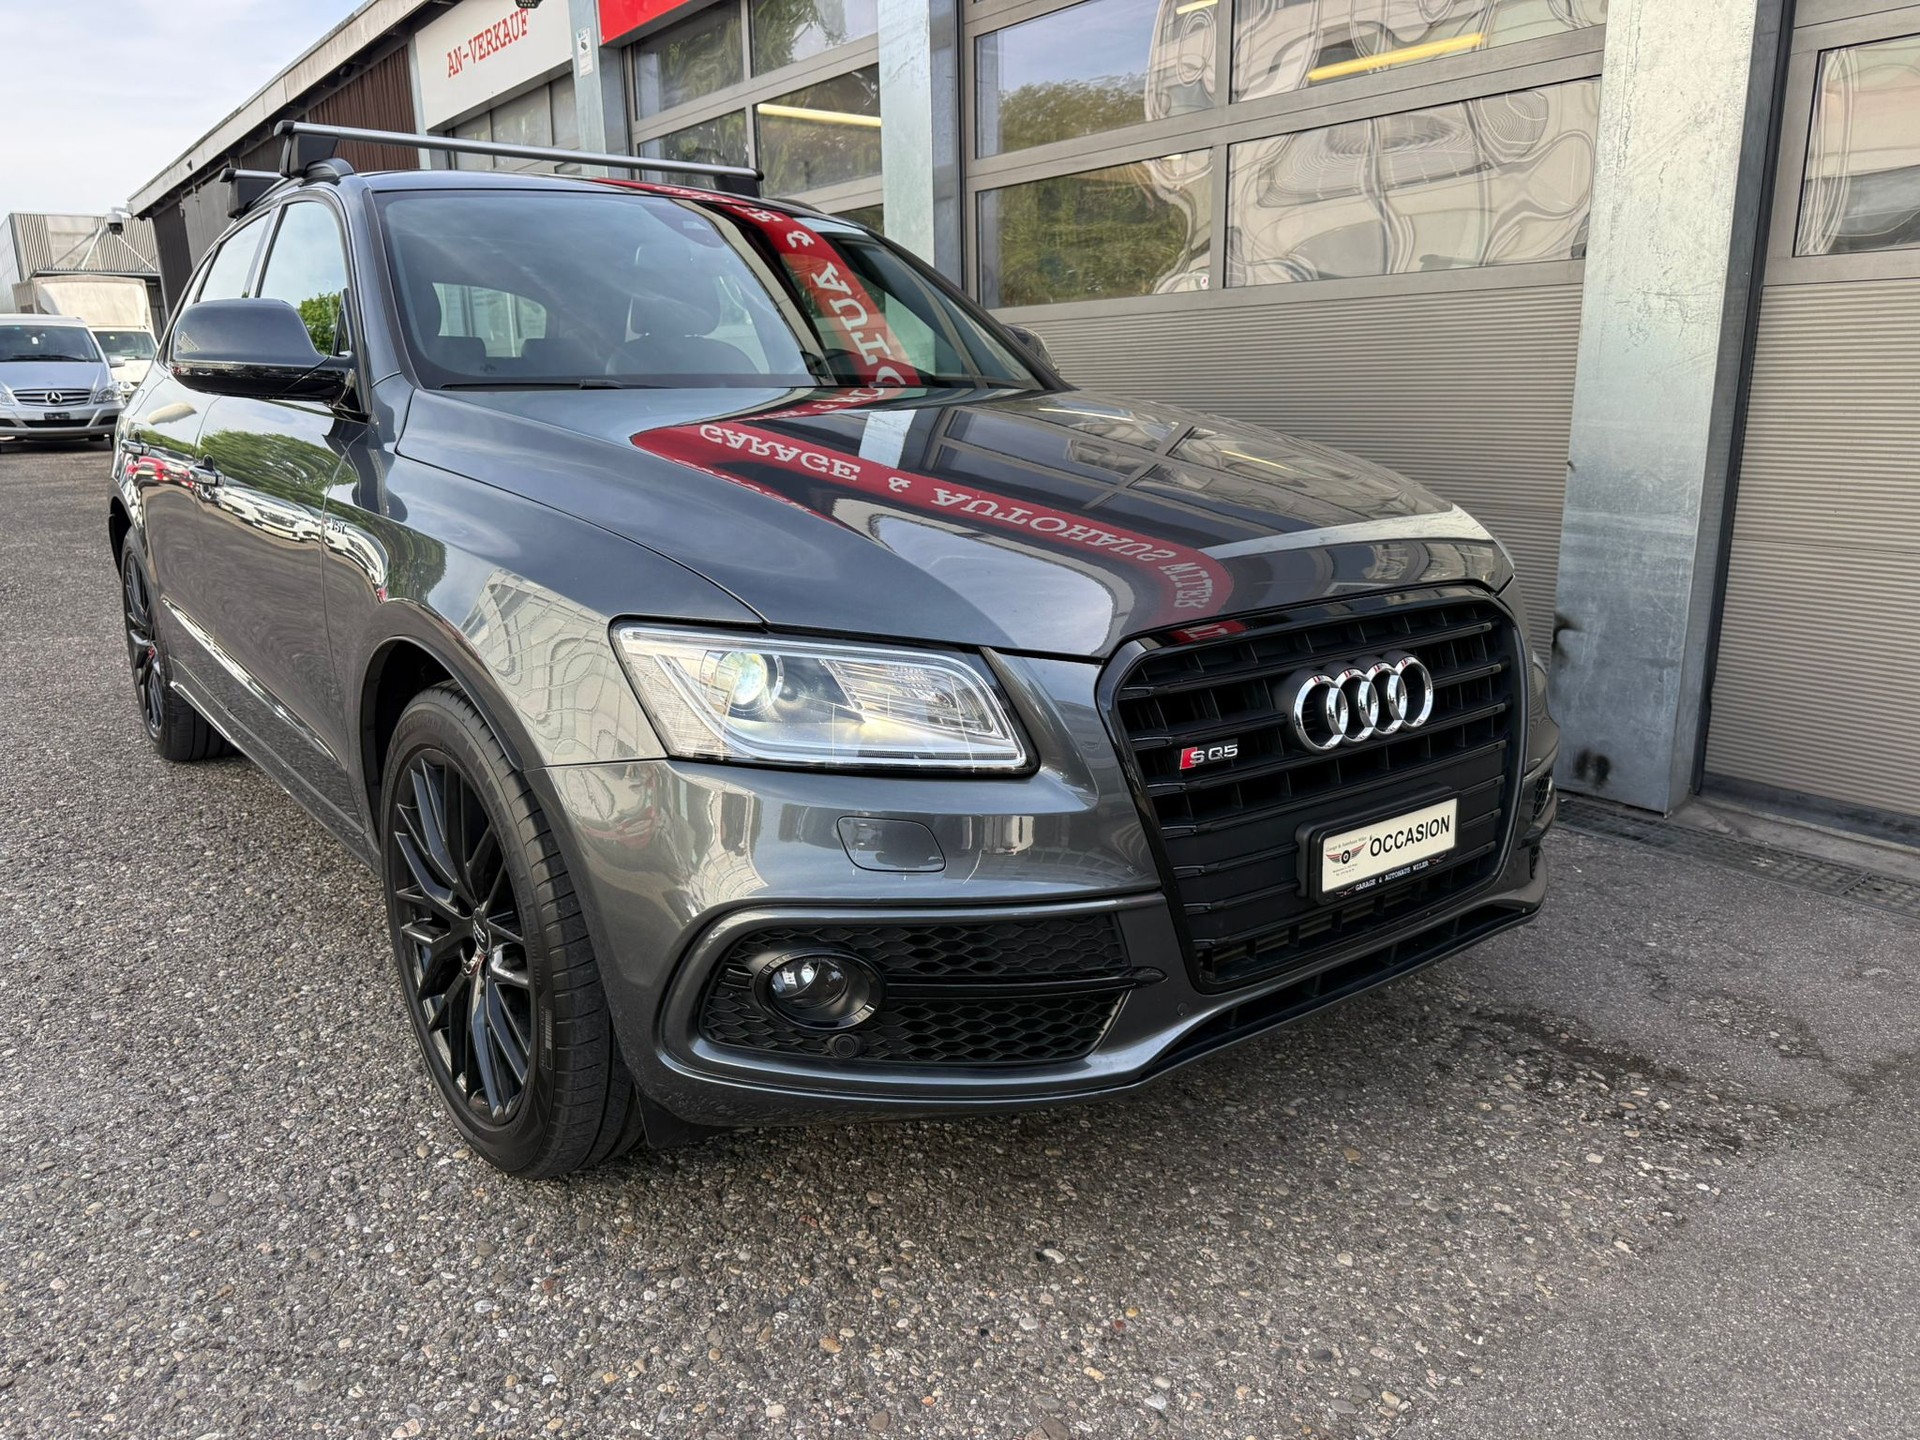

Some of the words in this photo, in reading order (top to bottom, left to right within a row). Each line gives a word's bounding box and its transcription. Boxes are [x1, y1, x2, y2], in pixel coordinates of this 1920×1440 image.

[447, 8, 529, 78] AN-VERKAUF
[1370, 815, 1450, 857] OCCASION
[1355, 878, 1377, 891] GARAGE
[1384, 866, 1411, 881] AUTOHAUS
